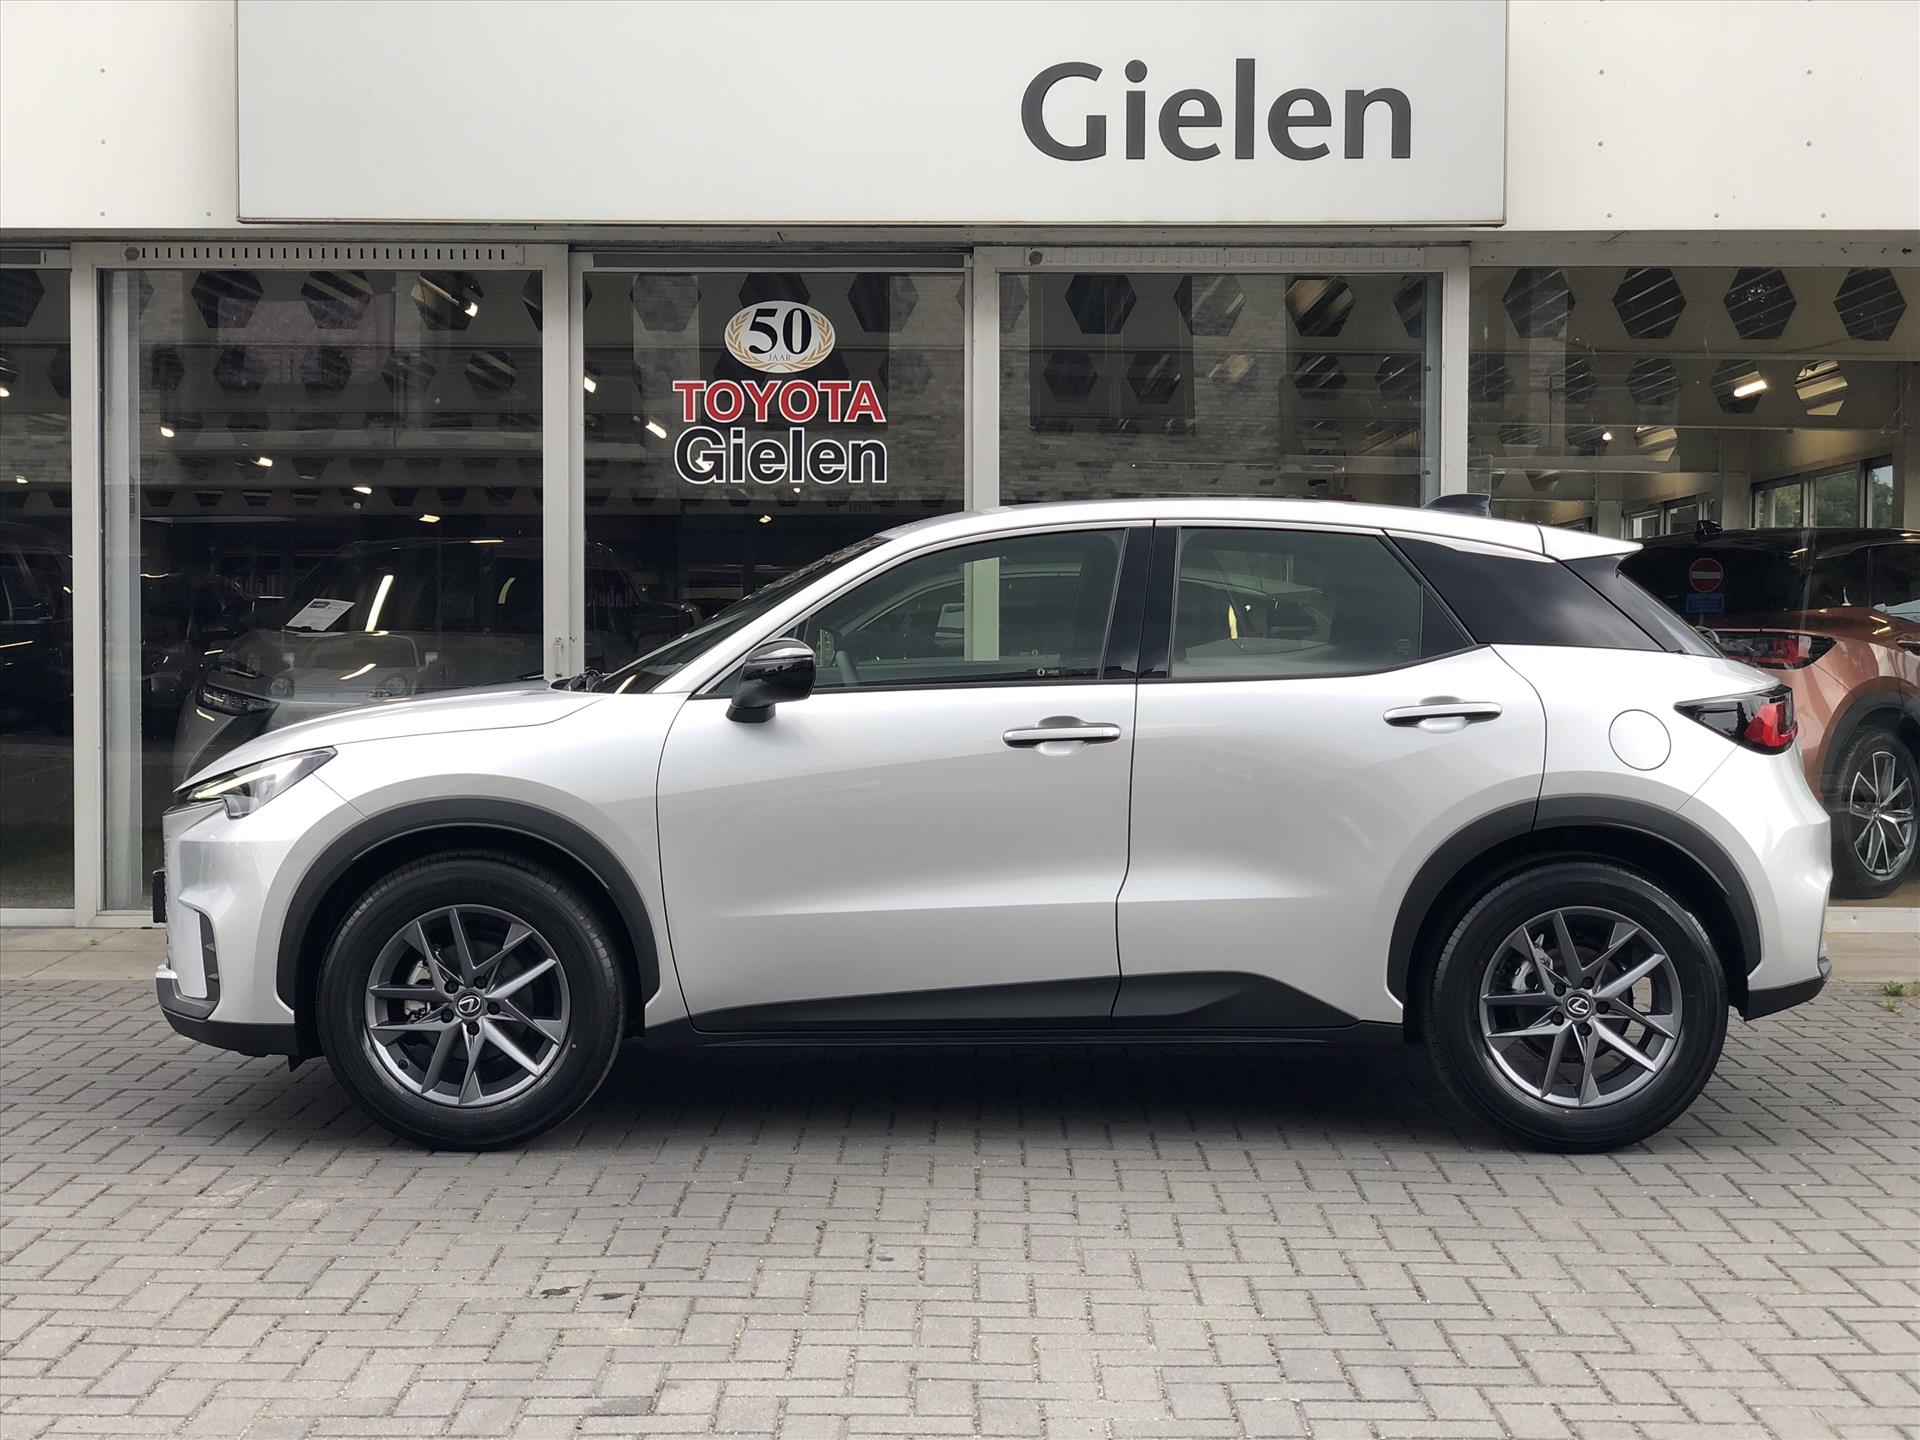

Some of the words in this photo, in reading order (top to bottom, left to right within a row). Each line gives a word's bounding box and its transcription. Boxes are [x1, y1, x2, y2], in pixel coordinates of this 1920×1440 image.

[1021, 58, 1411, 161] Gielen
[748, 308, 812, 355] 50
[767, 353, 792, 363] JAAR
[672, 380, 887, 423] TOYOTA
[674, 426, 888, 484] Gielen
